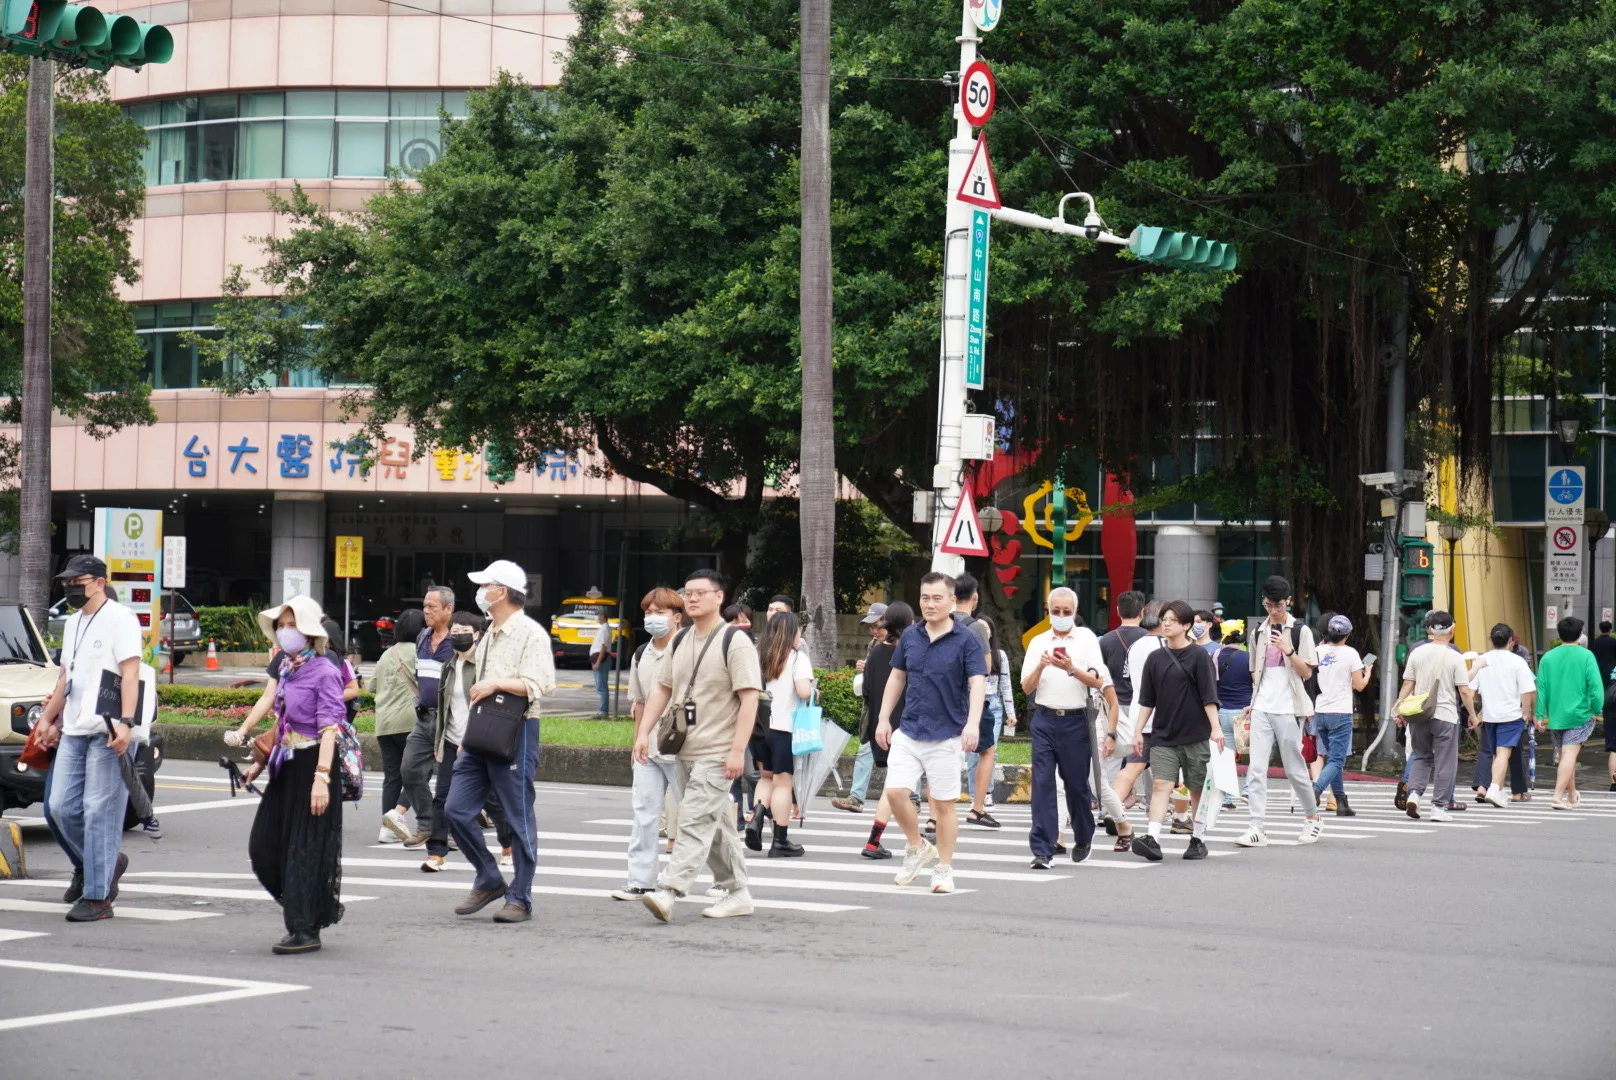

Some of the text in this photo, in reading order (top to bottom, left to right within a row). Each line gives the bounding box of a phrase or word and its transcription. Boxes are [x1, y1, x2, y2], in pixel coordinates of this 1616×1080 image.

[968, 80, 989, 108] 50
[972, 247, 983, 323] 中山南路
[1548, 507, 1583, 516] 行人優先
[127, 516, 141, 536] P
[1419, 549, 1429, 568] 6
